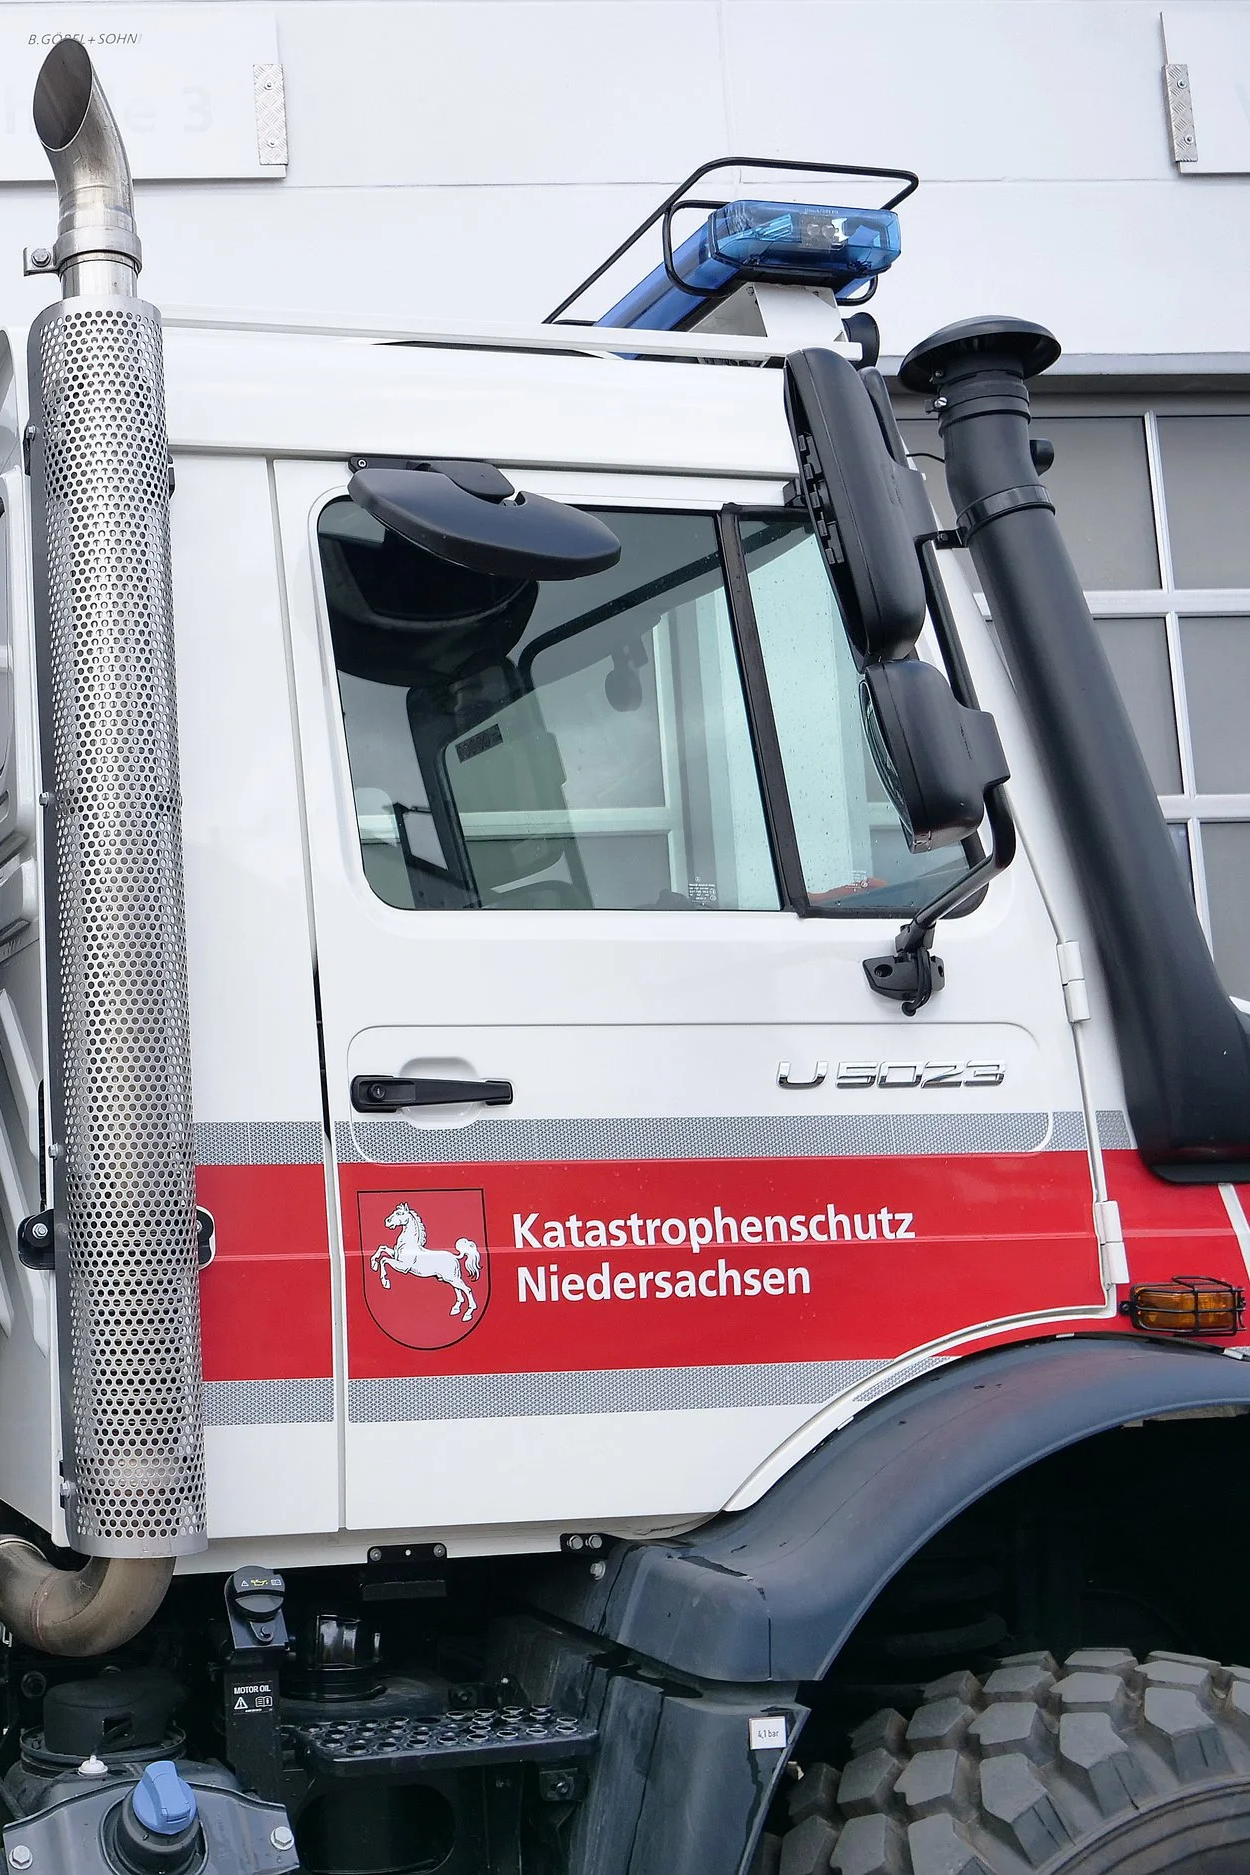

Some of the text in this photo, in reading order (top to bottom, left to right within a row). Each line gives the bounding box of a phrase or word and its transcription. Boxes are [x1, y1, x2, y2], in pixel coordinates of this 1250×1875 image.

[181, 86, 214, 133] 3
[776, 1060, 1007, 1090] U 5023
[512, 1203, 916, 1254] Katastrophenschutz
[517, 1258, 811, 1303] Niedersachsen
[233, 1684, 271, 1694] MOTOR OIL
[768, 1729, 779, 1738] bar
